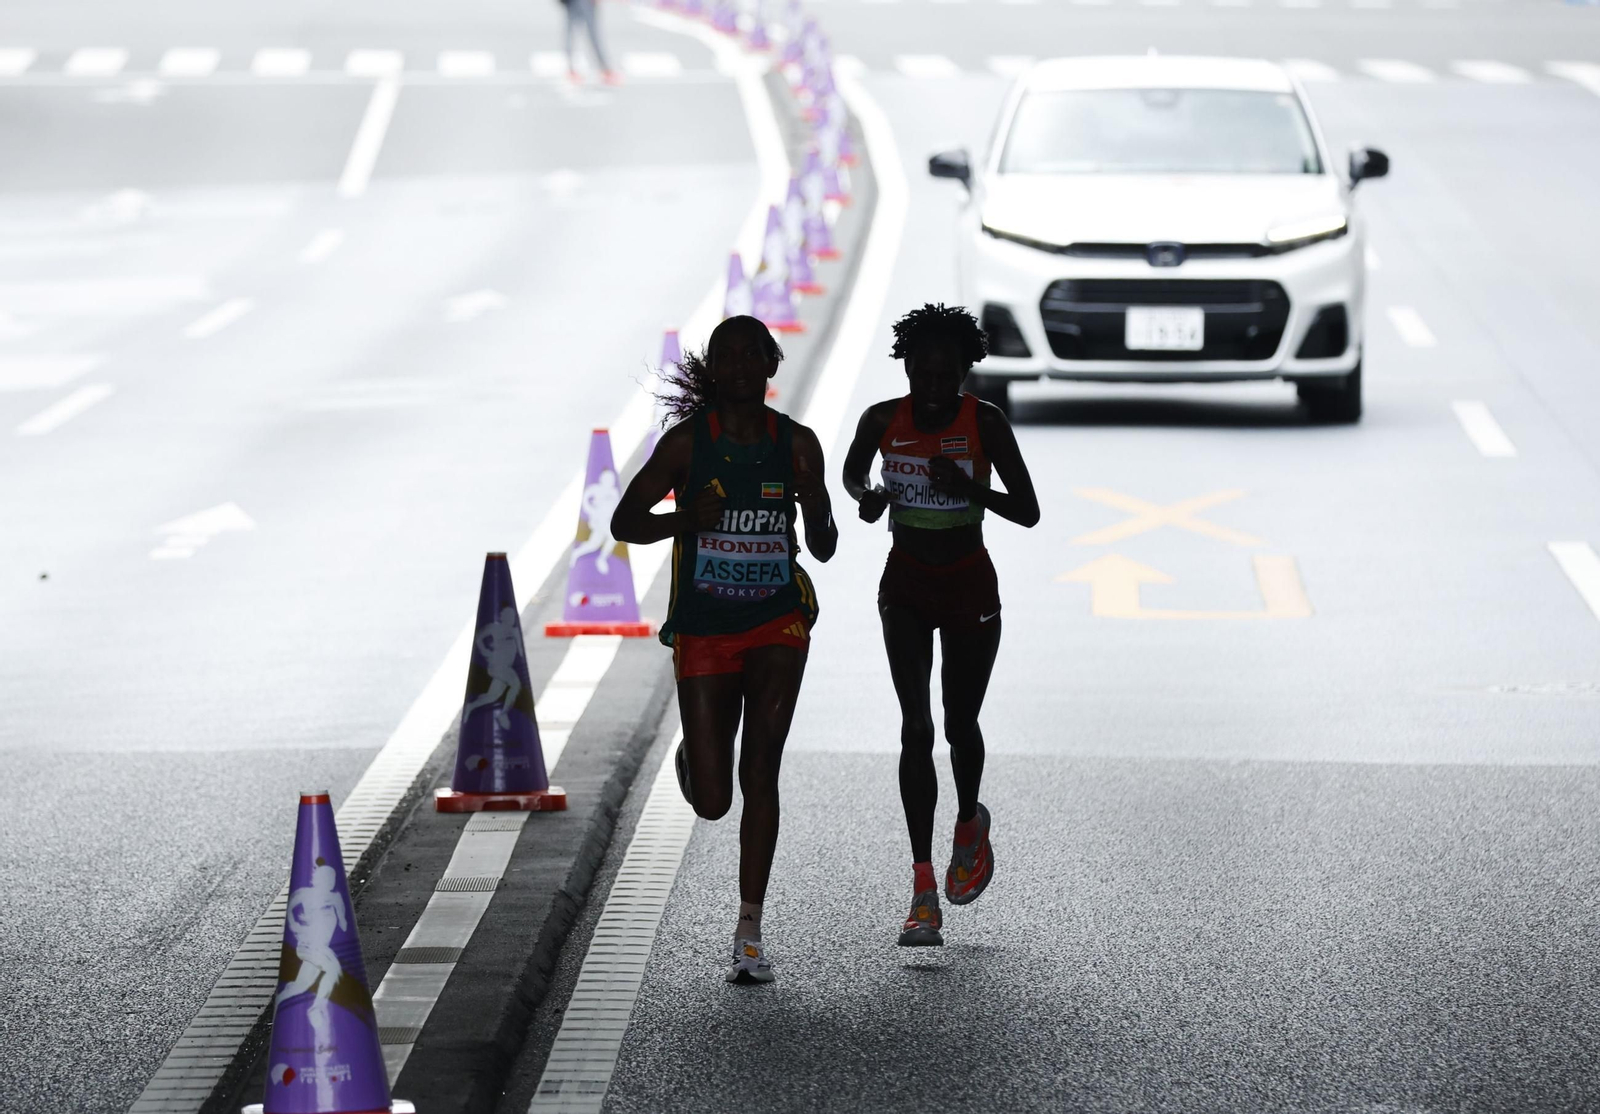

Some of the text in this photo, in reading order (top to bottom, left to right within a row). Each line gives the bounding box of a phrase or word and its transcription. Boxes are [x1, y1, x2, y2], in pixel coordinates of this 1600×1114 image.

[714, 509, 787, 533] HIOPIA
[699, 537, 787, 554] HONDA
[700, 559, 786, 583] ASSEFA
